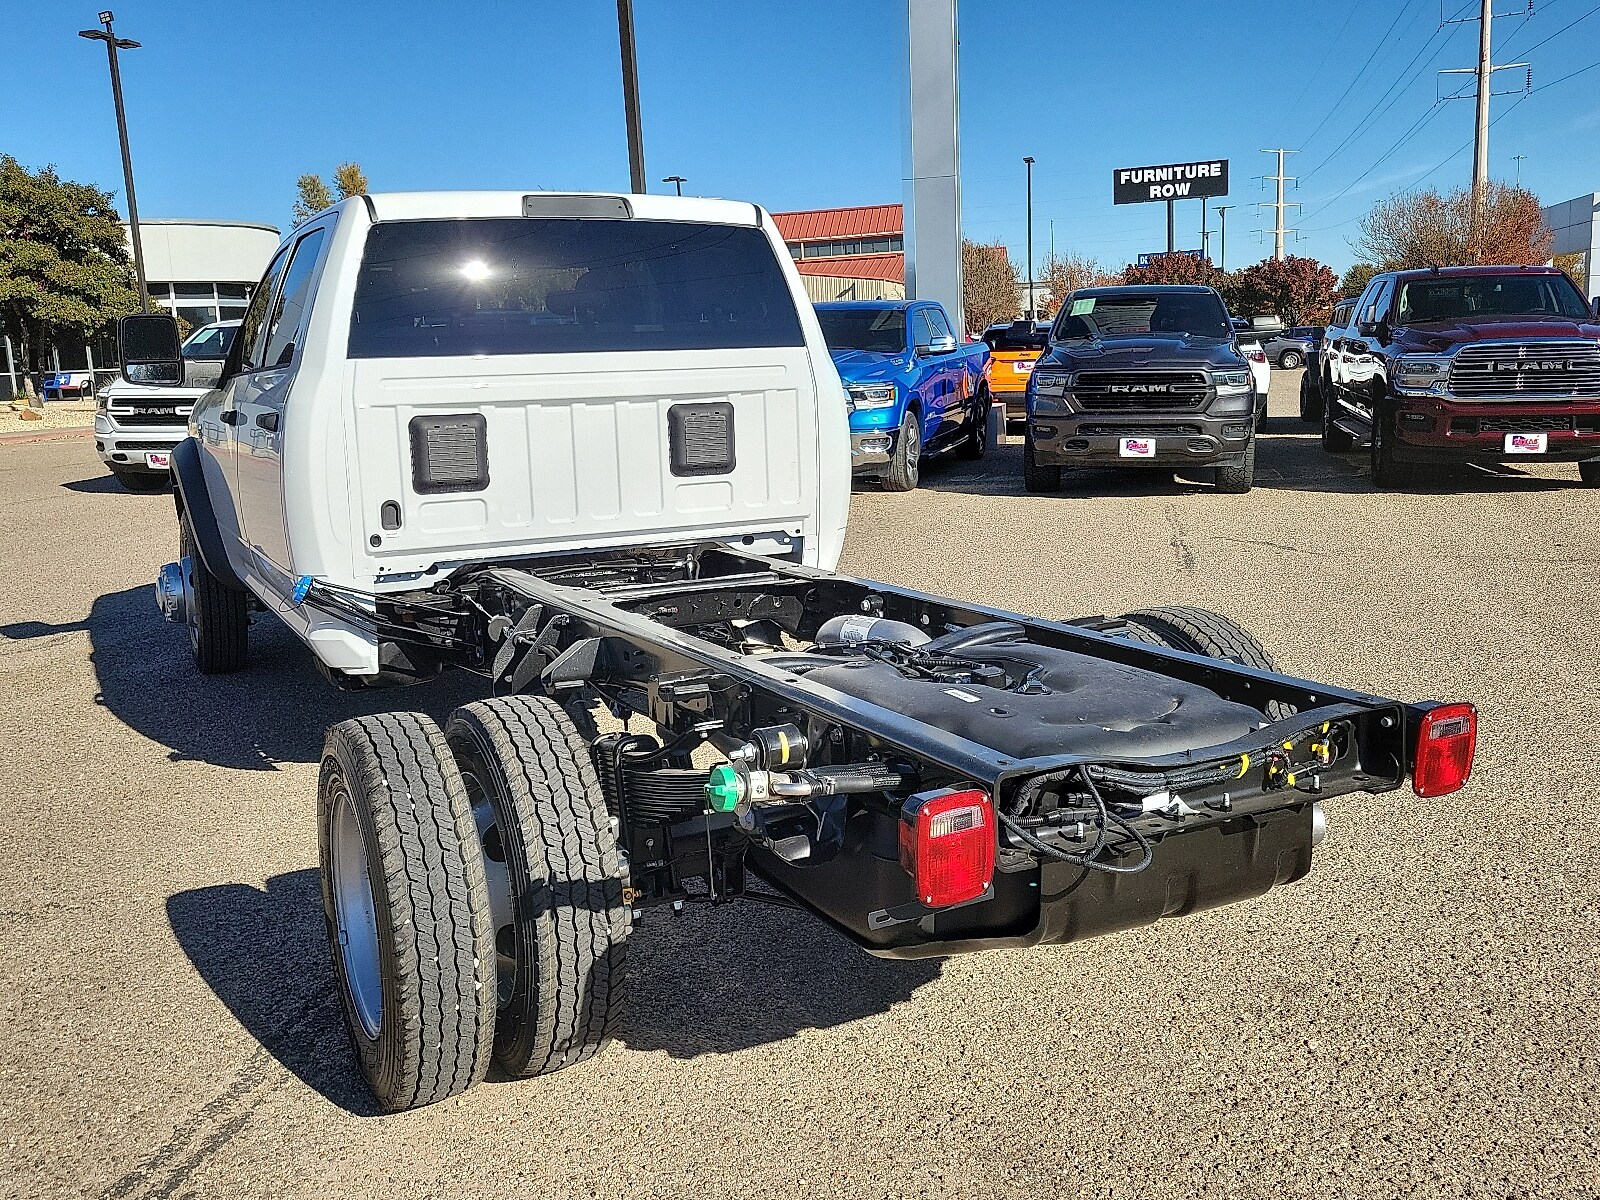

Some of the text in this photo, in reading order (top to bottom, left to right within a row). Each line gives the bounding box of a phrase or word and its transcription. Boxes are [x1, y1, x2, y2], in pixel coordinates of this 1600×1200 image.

[1120, 163, 1222, 185] FURNITURE
[1149, 182, 1191, 199] ROW
[1497, 360, 1564, 371] RAM
[1111, 384, 1168, 393] RAM
[134, 407, 174, 415] RAM
